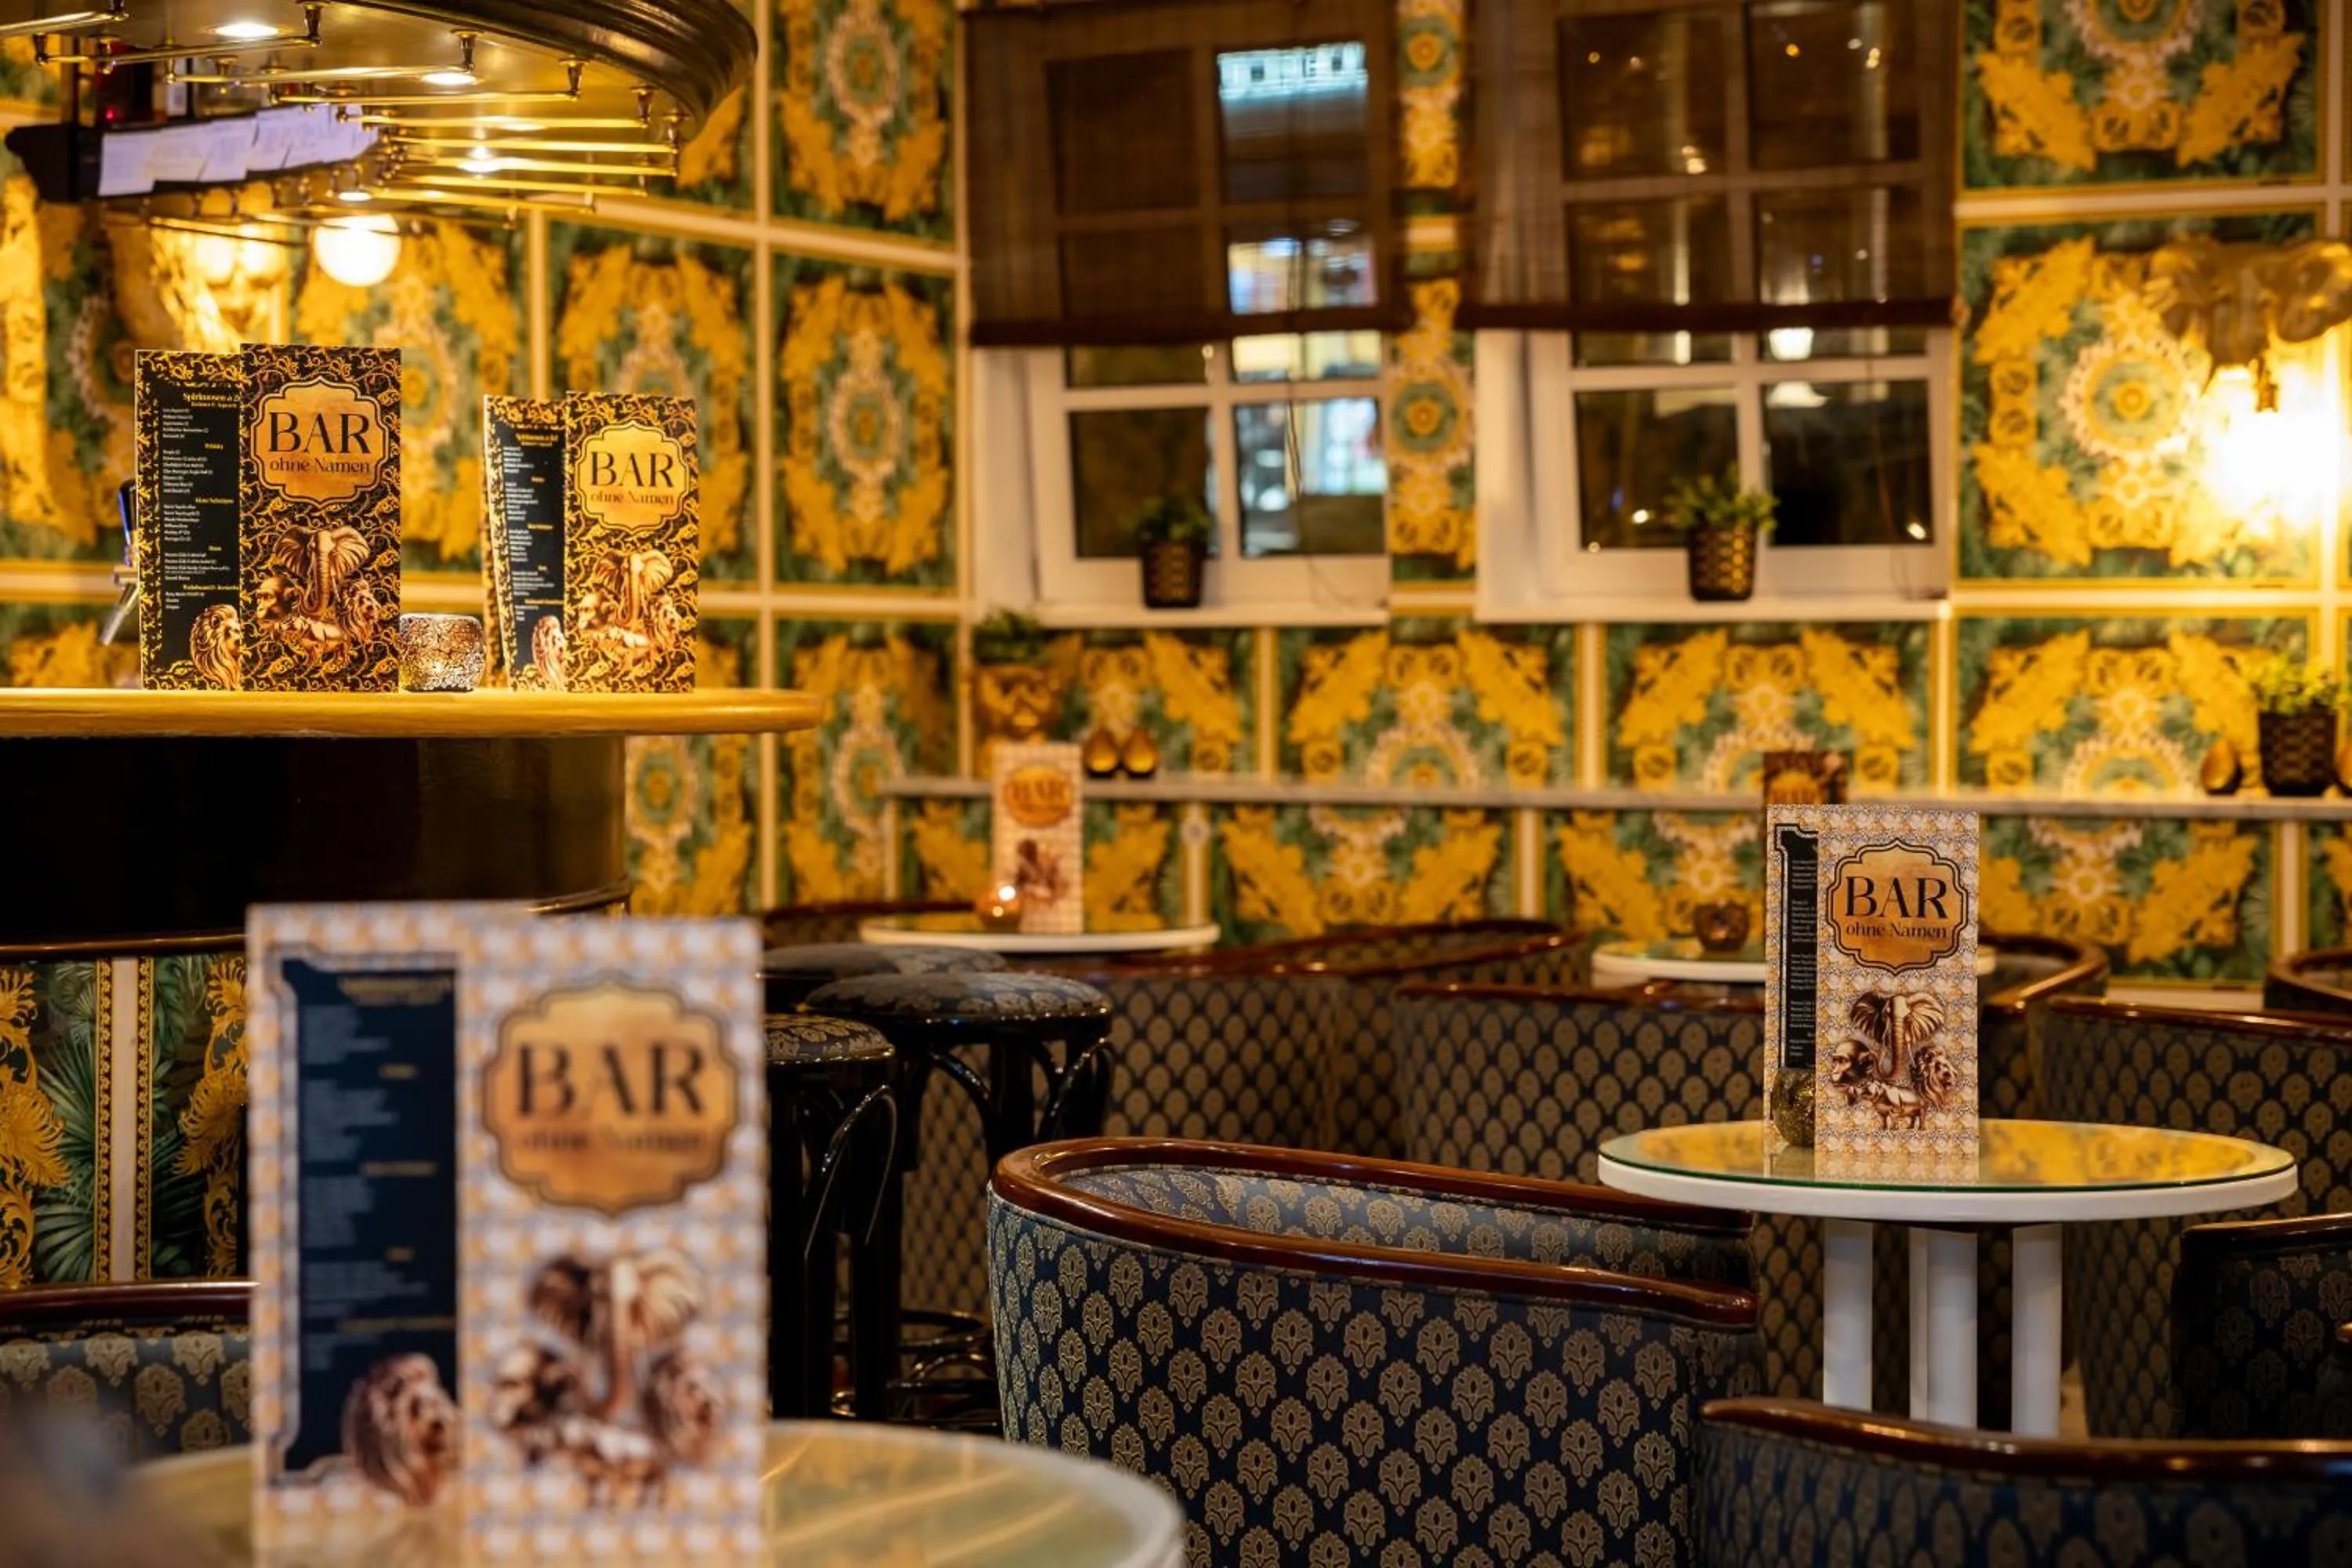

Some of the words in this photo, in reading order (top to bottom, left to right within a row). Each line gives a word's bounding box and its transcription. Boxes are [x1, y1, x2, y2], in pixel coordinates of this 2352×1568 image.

[269, 412, 371, 454] BAR
[270, 457, 310, 471] ohne
[314, 457, 370, 473] Namen
[590, 451, 674, 488] BAR
[591, 490, 624, 503] ohne
[1845, 876, 1948, 919] BAR
[1846, 921, 1886, 937] ohne
[1891, 922, 1947, 938] Namen
[517, 1041, 705, 1116] BAR
